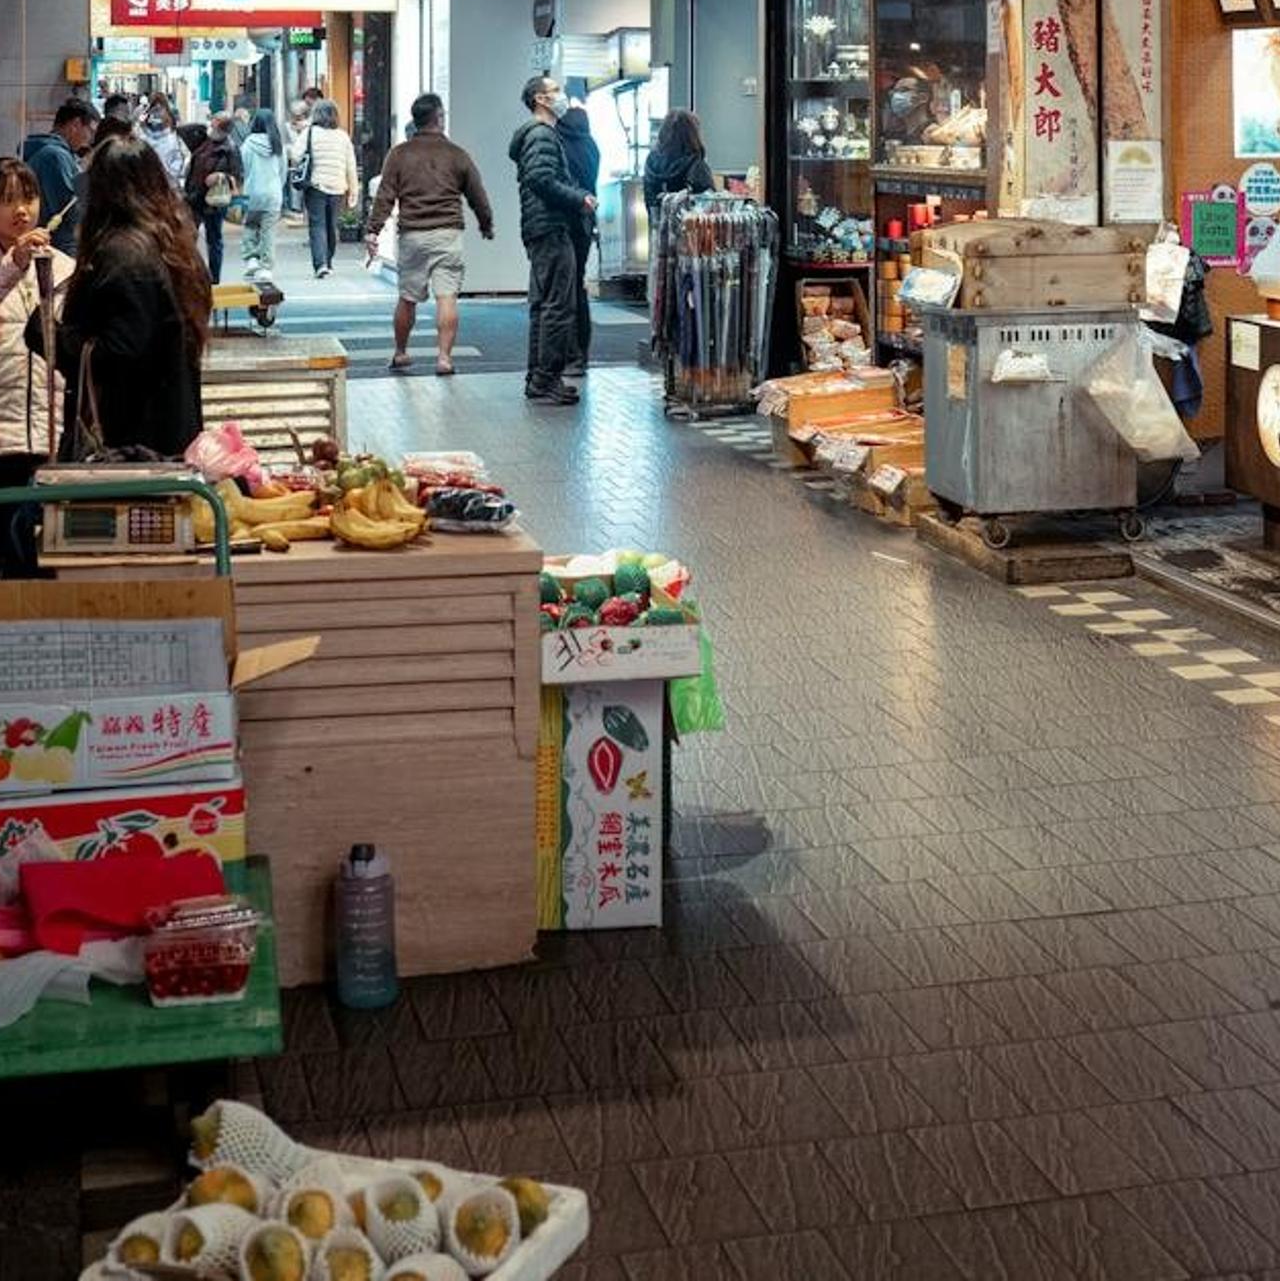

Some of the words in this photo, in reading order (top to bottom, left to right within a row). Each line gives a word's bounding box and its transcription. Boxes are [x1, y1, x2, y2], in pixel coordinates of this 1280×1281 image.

[1032, 17, 1062, 143] 豬大郎
[598, 811, 624, 908] 網室木瓜
